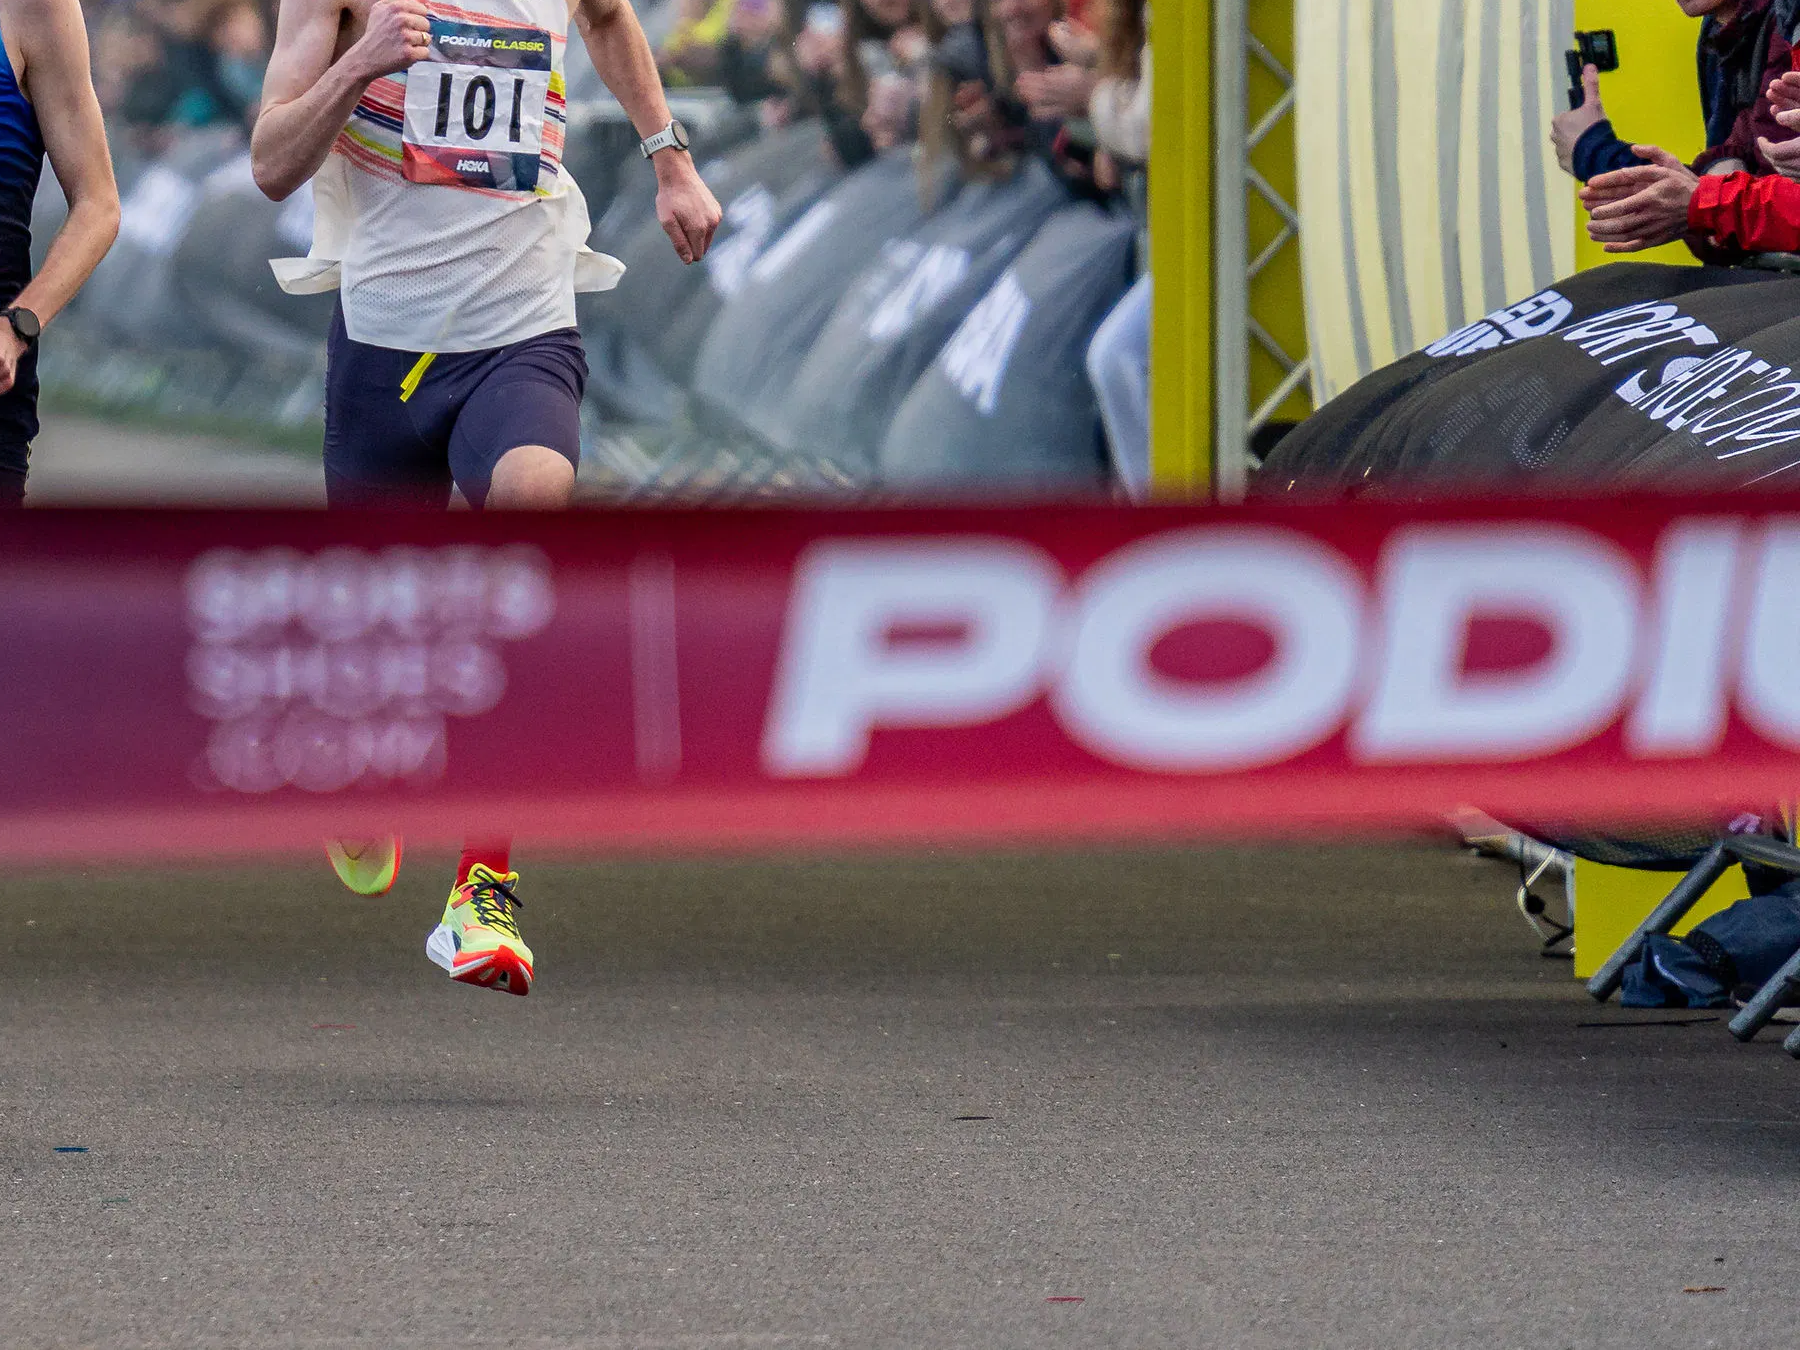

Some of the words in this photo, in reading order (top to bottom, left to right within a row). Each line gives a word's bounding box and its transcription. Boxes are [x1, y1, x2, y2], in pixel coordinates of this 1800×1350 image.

[438, 35, 492, 49] PODIUM
[492, 38, 545, 52] CLASSIC
[434, 72, 525, 142] 101
[456, 159, 490, 173] HOKA
[765, 520, 1800, 777] PODI
